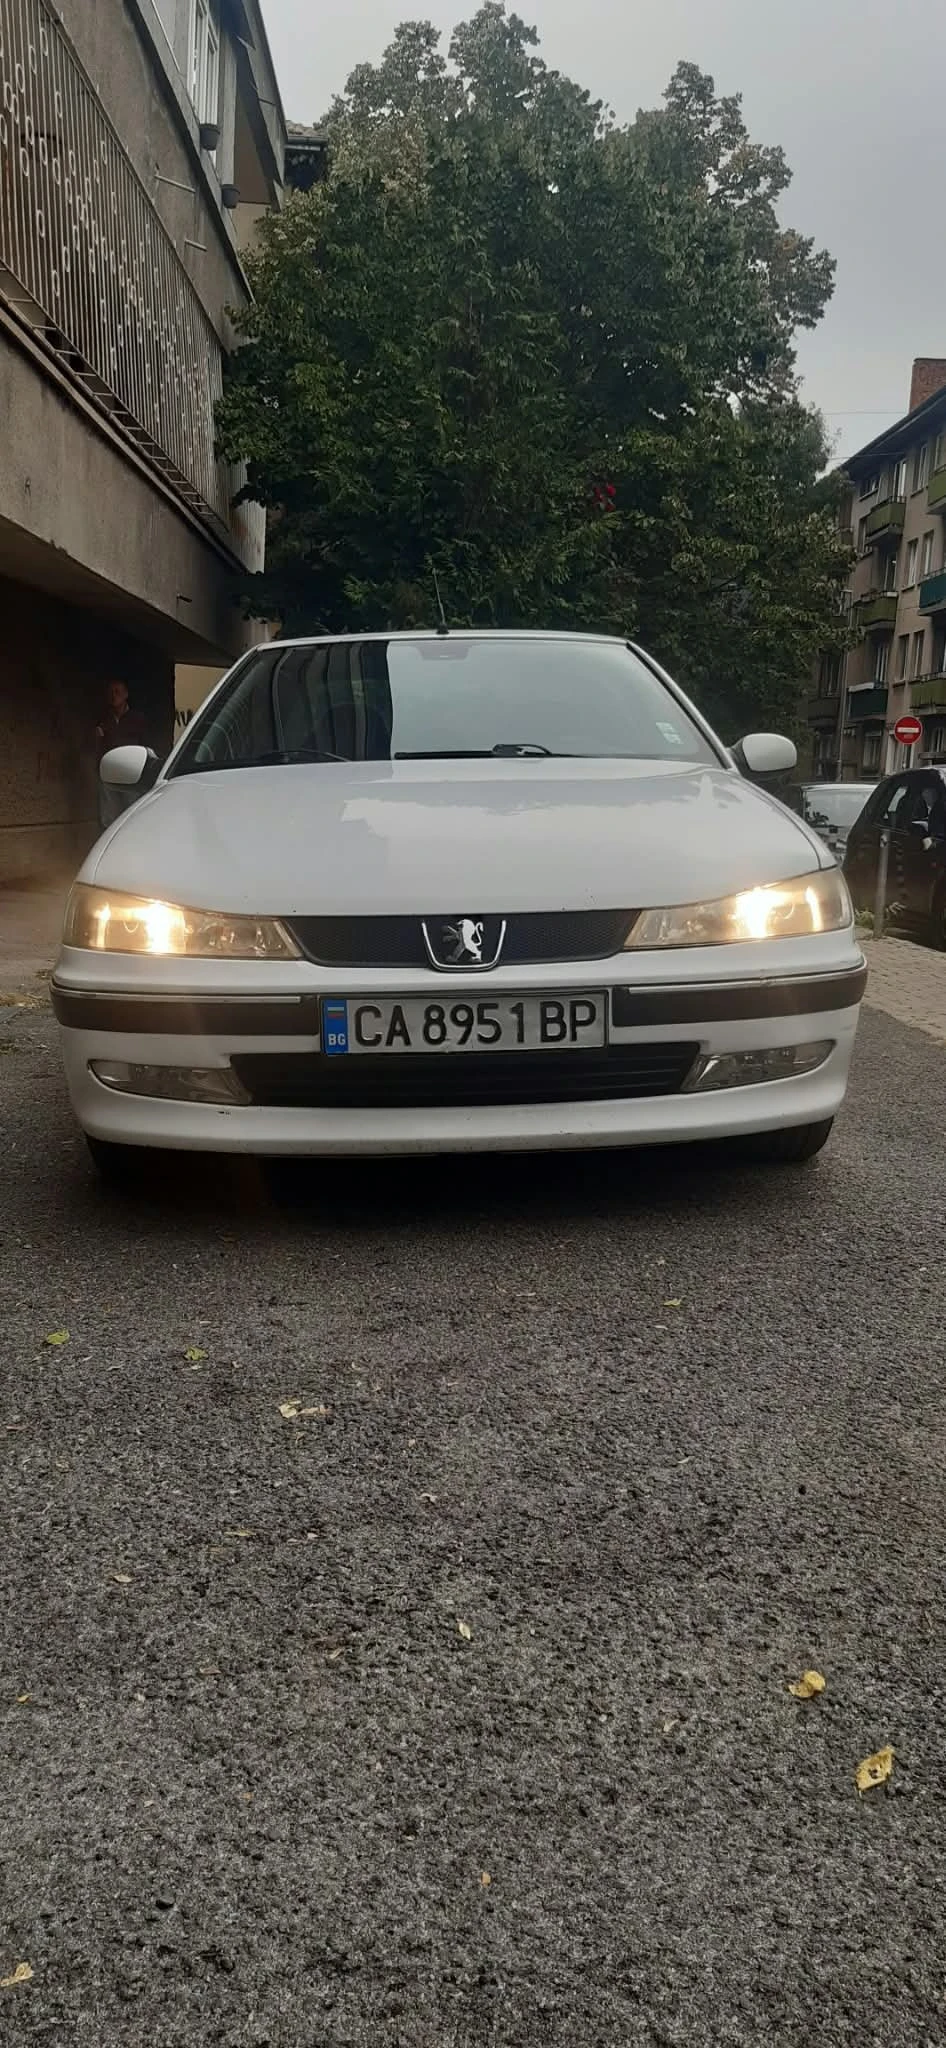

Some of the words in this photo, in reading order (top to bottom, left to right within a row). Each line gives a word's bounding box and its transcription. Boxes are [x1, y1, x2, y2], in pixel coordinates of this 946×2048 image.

[354, 1004, 411, 1046] CA
[422, 1002, 525, 1045] 8951
[540, 1000, 596, 1043] BP
[328, 1034, 346, 1046] BG
